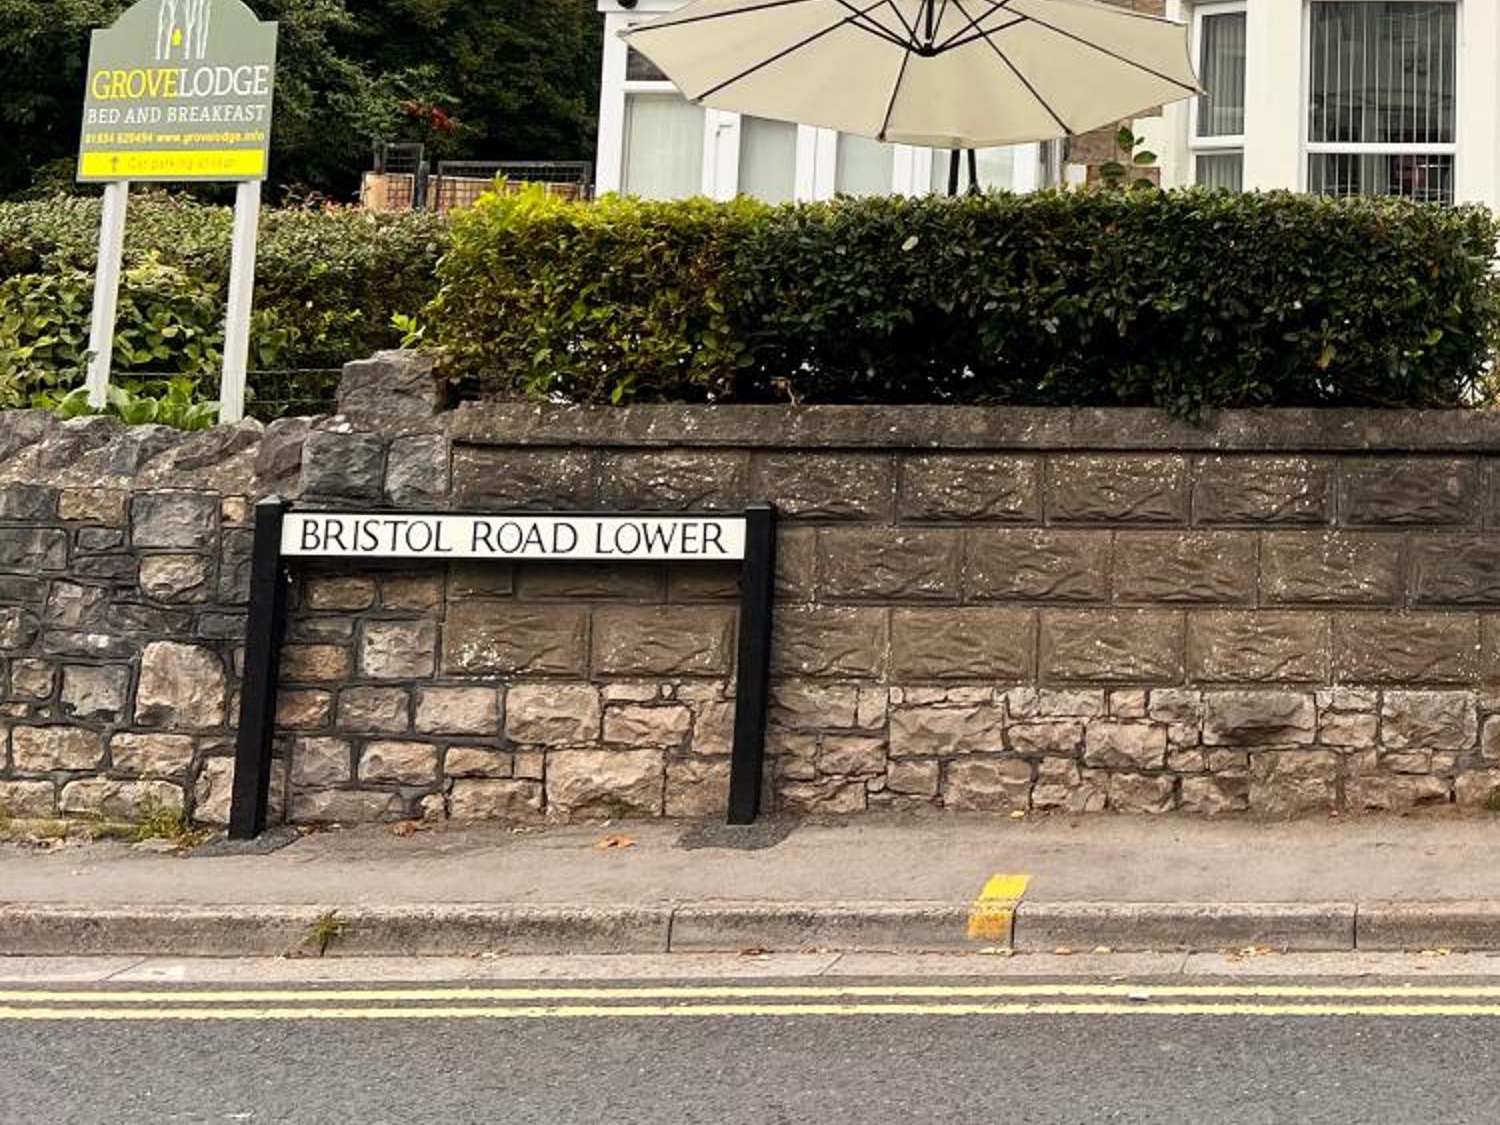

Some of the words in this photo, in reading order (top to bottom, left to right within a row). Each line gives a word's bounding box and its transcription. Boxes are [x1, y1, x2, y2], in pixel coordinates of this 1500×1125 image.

[88, 108, 120, 124] BED
[125, 106, 161, 123] AND
[167, 104, 266, 122] BREAKFAST
[300, 519, 452, 553] BRISTOL
[471, 521, 578, 554] ROAD
[594, 522, 727, 554] LOWER
